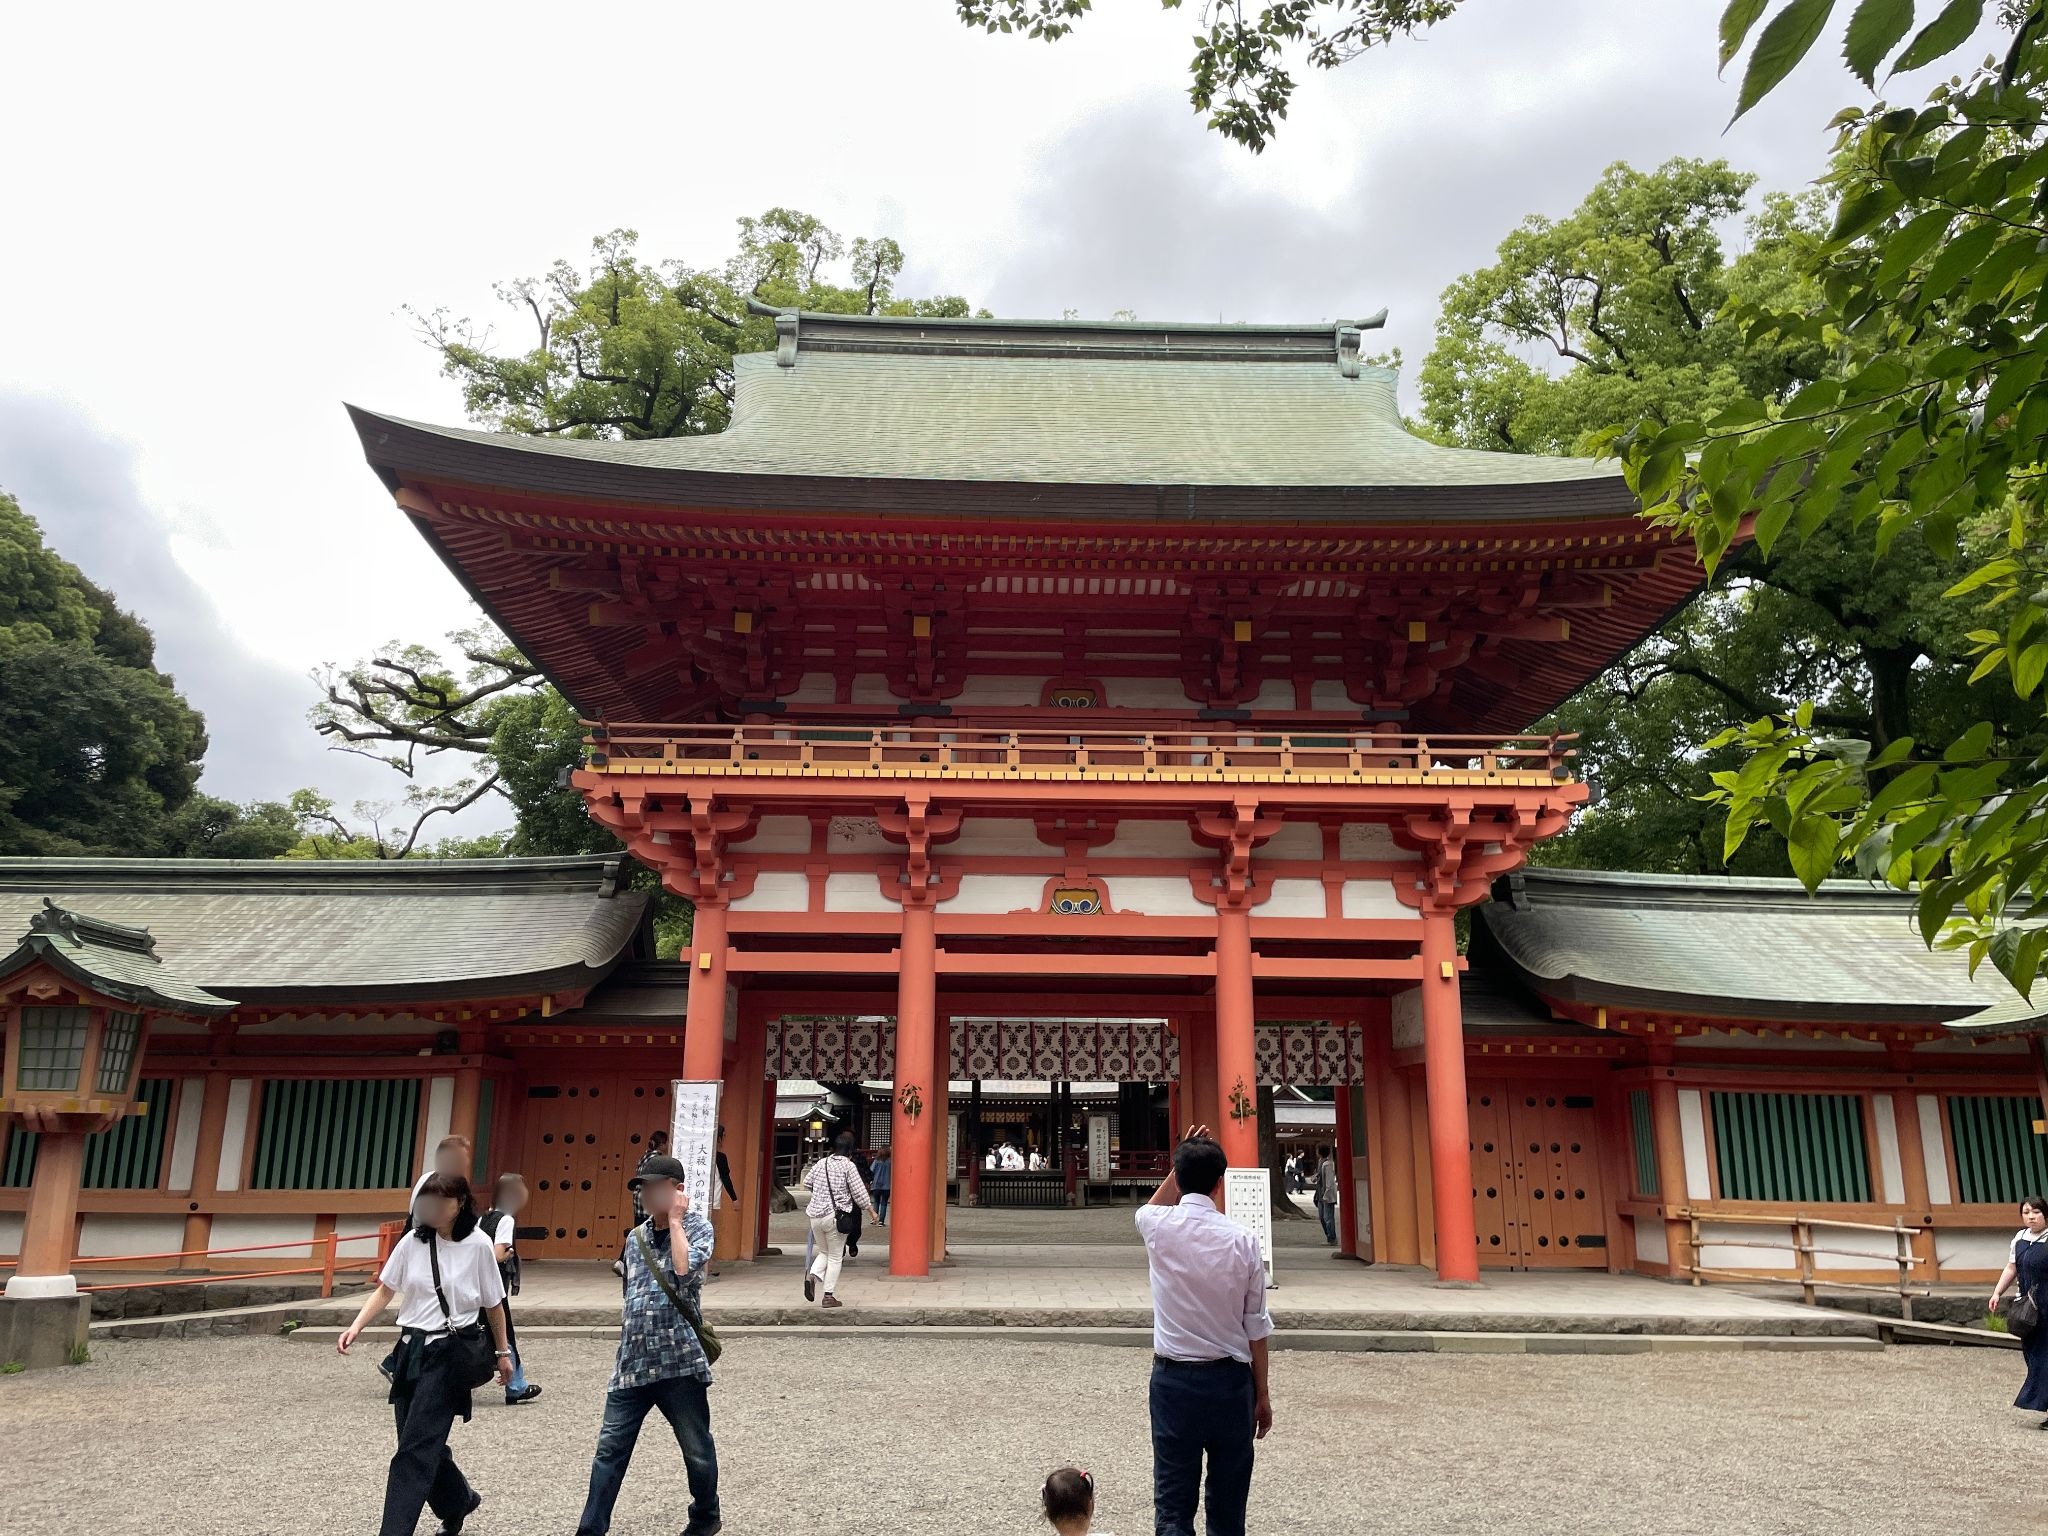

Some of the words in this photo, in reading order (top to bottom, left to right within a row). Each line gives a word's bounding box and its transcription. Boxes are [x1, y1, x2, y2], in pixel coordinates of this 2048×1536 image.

[693, 1143, 708, 1219] 大祓いの御案
